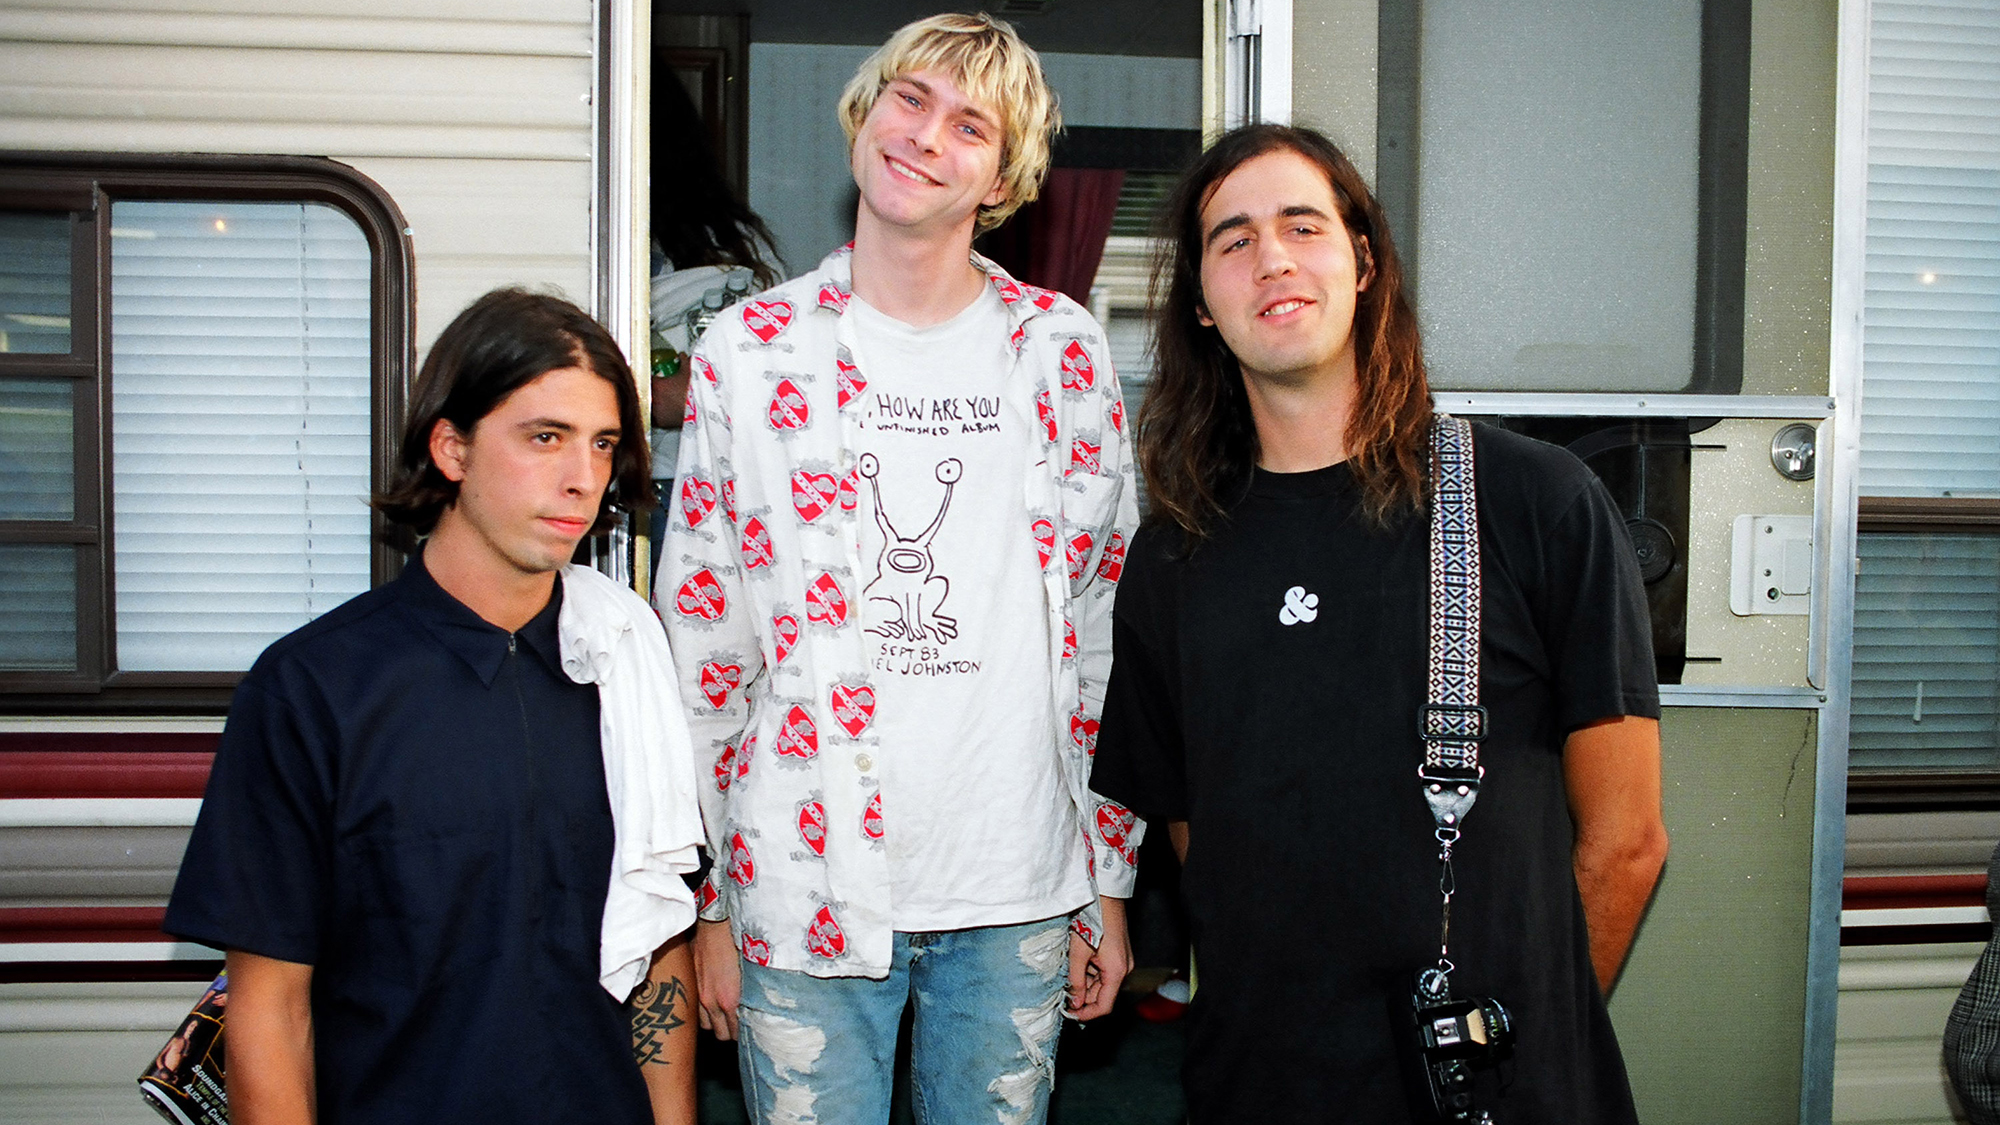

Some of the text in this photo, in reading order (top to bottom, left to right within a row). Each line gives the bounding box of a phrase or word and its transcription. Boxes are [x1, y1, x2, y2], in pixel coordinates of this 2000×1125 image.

[876, 393, 1000, 422] HOW ARE YOU
[961, 422, 1001, 434] ALBUM
[1279, 585, 1320, 626] &
[880, 643, 940, 661] SEPT 83
[900, 660, 982, 676] JOHNSTON
